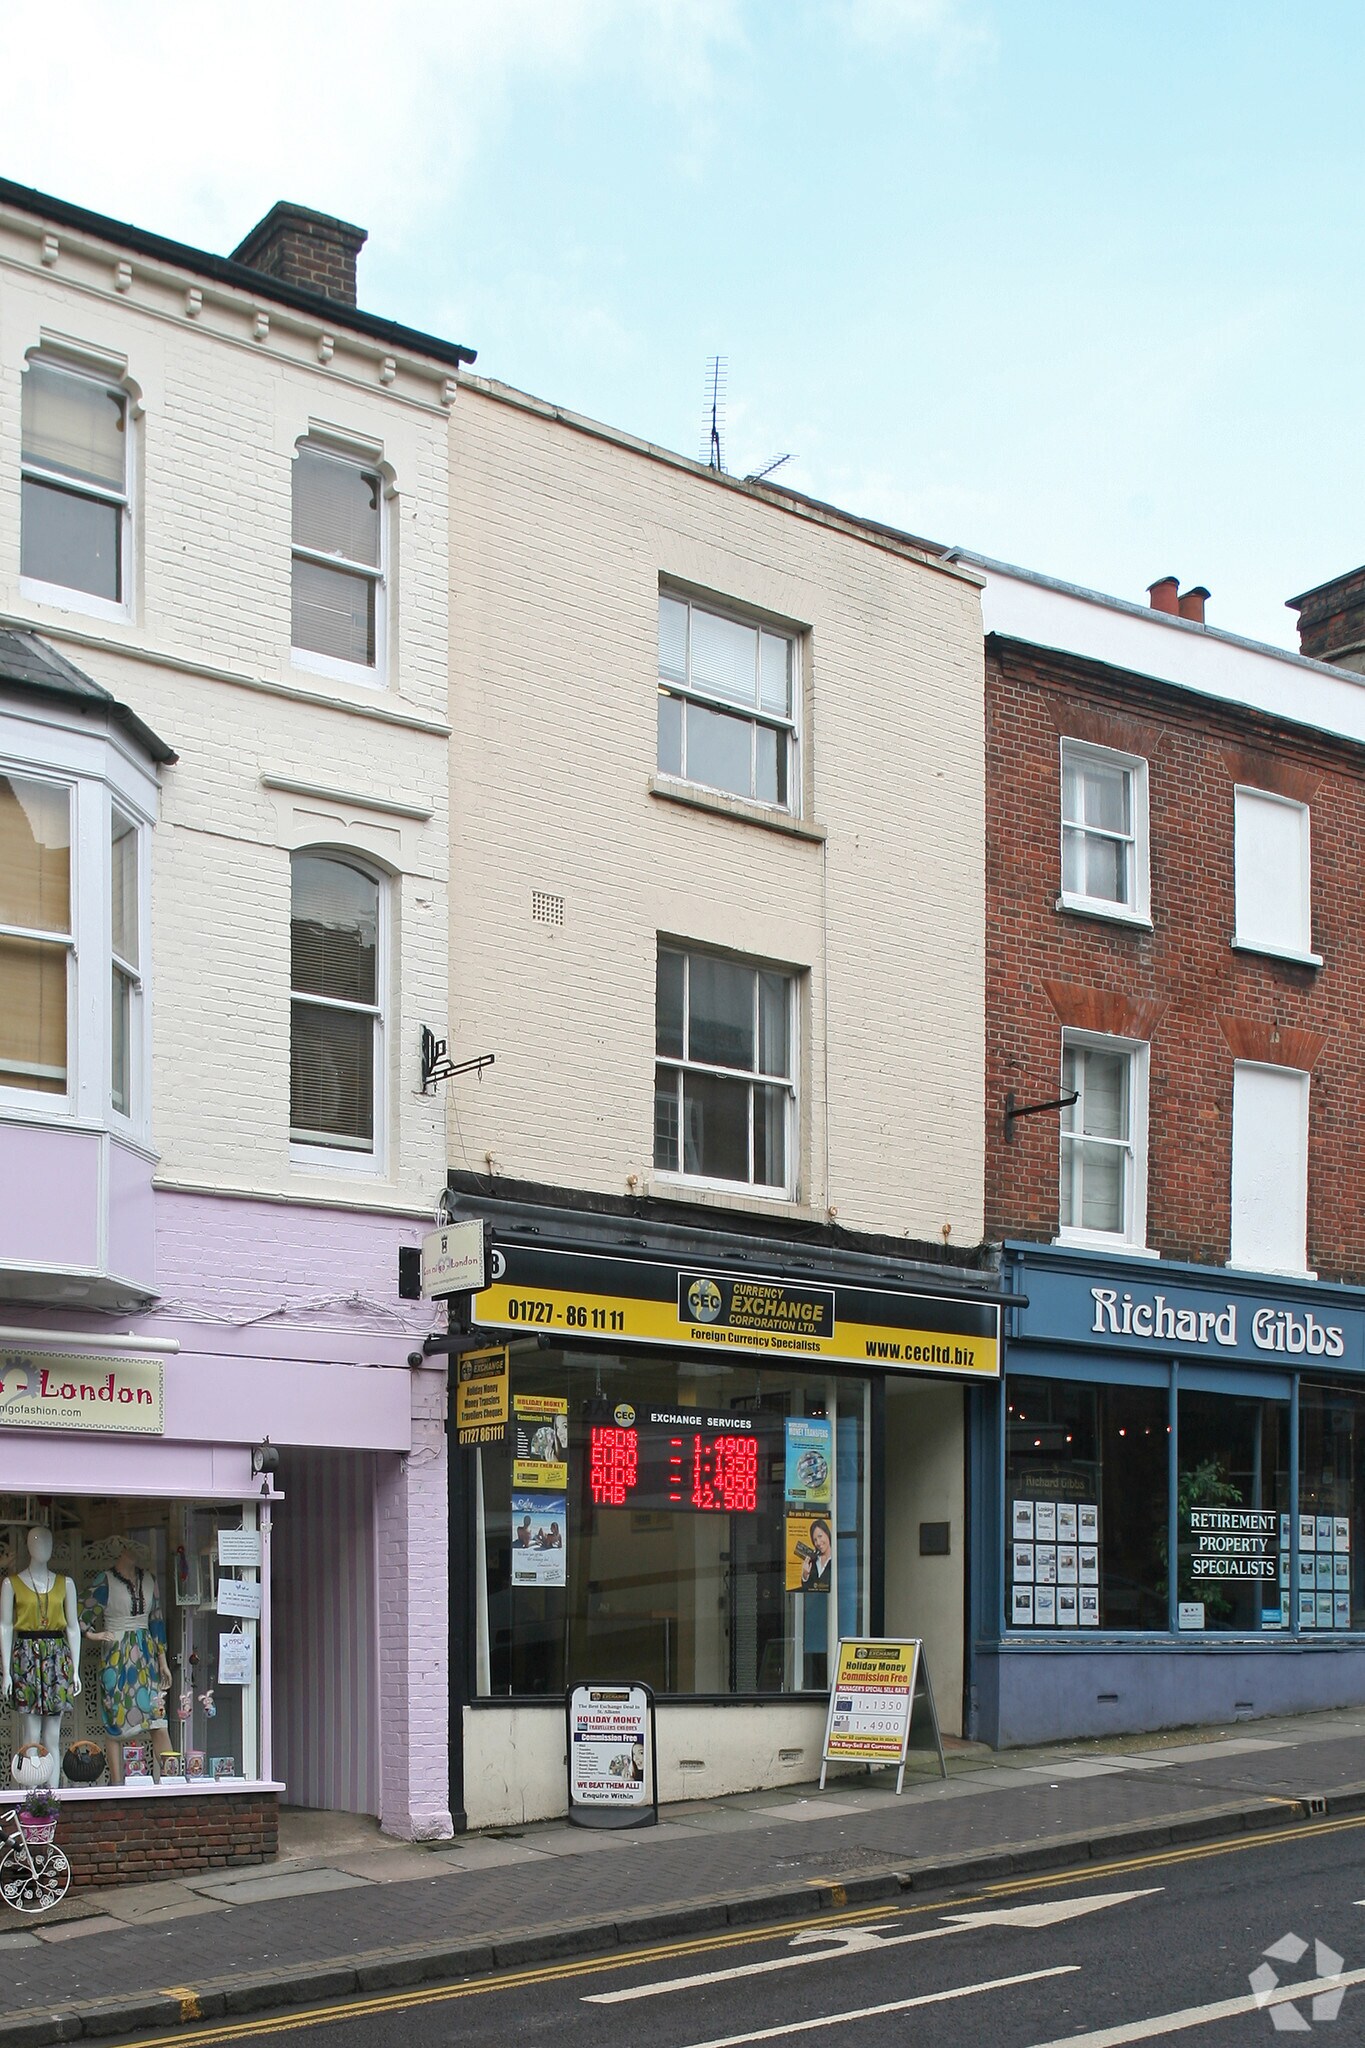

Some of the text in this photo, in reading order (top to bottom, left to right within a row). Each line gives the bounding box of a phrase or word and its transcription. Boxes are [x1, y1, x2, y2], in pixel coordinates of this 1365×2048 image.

[451, 1256, 478, 1268] London
[733, 1283, 784, 1299] CURRENCY
[690, 1293, 720, 1309] CEC
[730, 1295, 824, 1321] EXCHANGE
[508, 1299, 553, 1324] 01727
[566, 1305, 588, 1328] 86
[728, 1314, 817, 1333] CORPORATION LTD.
[1090, 1288, 1345, 1357] Richard Gibbs
[691, 1328, 821, 1352] Foreign Currency Specialists
[865, 1341, 975, 1366] www.cecltd.biz
[40, 1369, 153, 1404] London
[484, 1384, 498, 1393] Money
[464, 1399, 479, 1409] Money
[615, 1411, 752, 1429] CEC EXCHANGE SERVICES
[459, 1425, 505, 1445] 01727 861111
[591, 1428, 638, 1448] USD$
[694, 1434, 758, 1456] 1.4900
[591, 1447, 638, 1467] EURO
[693, 1453, 758, 1474] 1.1350
[591, 1466, 637, 1487] AUD$
[693, 1471, 758, 1492] 1.4050
[1025, 1476, 1086, 1489] Richard Gibbs
[591, 1486, 626, 1505] THB
[692, 1491, 758, 1511] 42.500
[1191, 1513, 1276, 1530] RETIREMENT
[1199, 1536, 1268, 1552] PROPERTY
[1192, 1559, 1275, 1576] SPECIALISTS
[846, 1661, 906, 1672] Holiday Money
[841, 1671, 908, 1682] Commission Free
[858, 1701, 902, 1711] 1.1350
[577, 1716, 641, 1724] HOLIDAY MONEY
[855, 1721, 899, 1731] 1.4900
[581, 1733, 637, 1742] Commission Free
[582, 1792, 609, 1800] Enquire
